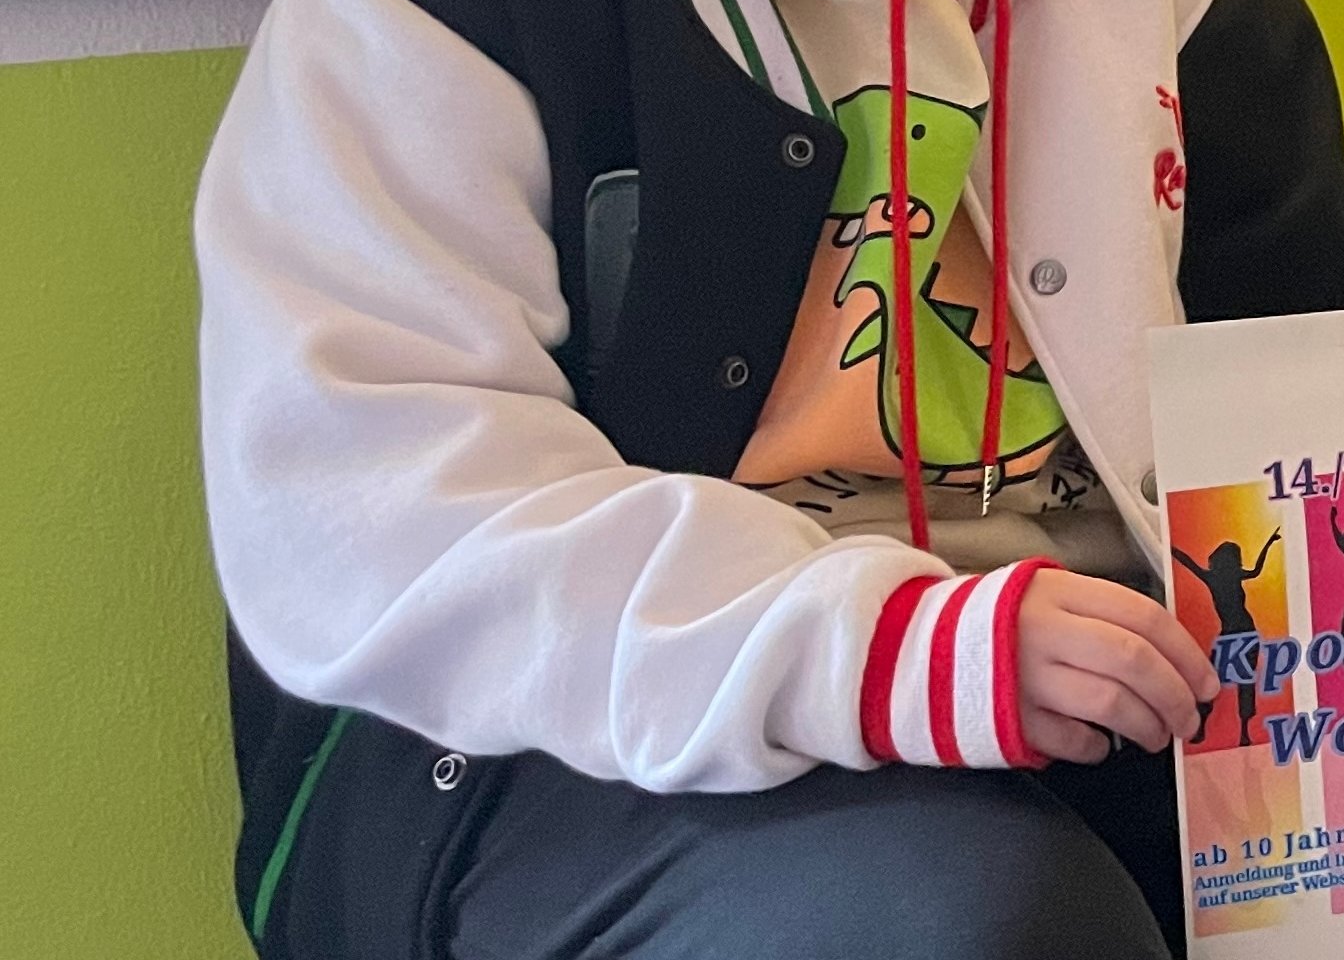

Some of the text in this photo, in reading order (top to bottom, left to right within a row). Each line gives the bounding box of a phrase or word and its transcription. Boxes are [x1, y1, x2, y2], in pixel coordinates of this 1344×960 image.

[1193, 843, 1228, 868] ab
[1241, 837, 1273, 860] 10
[1194, 865, 1295, 890] Anmeldung
[1298, 853, 1331, 873] und
[1197, 890, 1229, 909] auf
[1231, 880, 1300, 902] unserer
